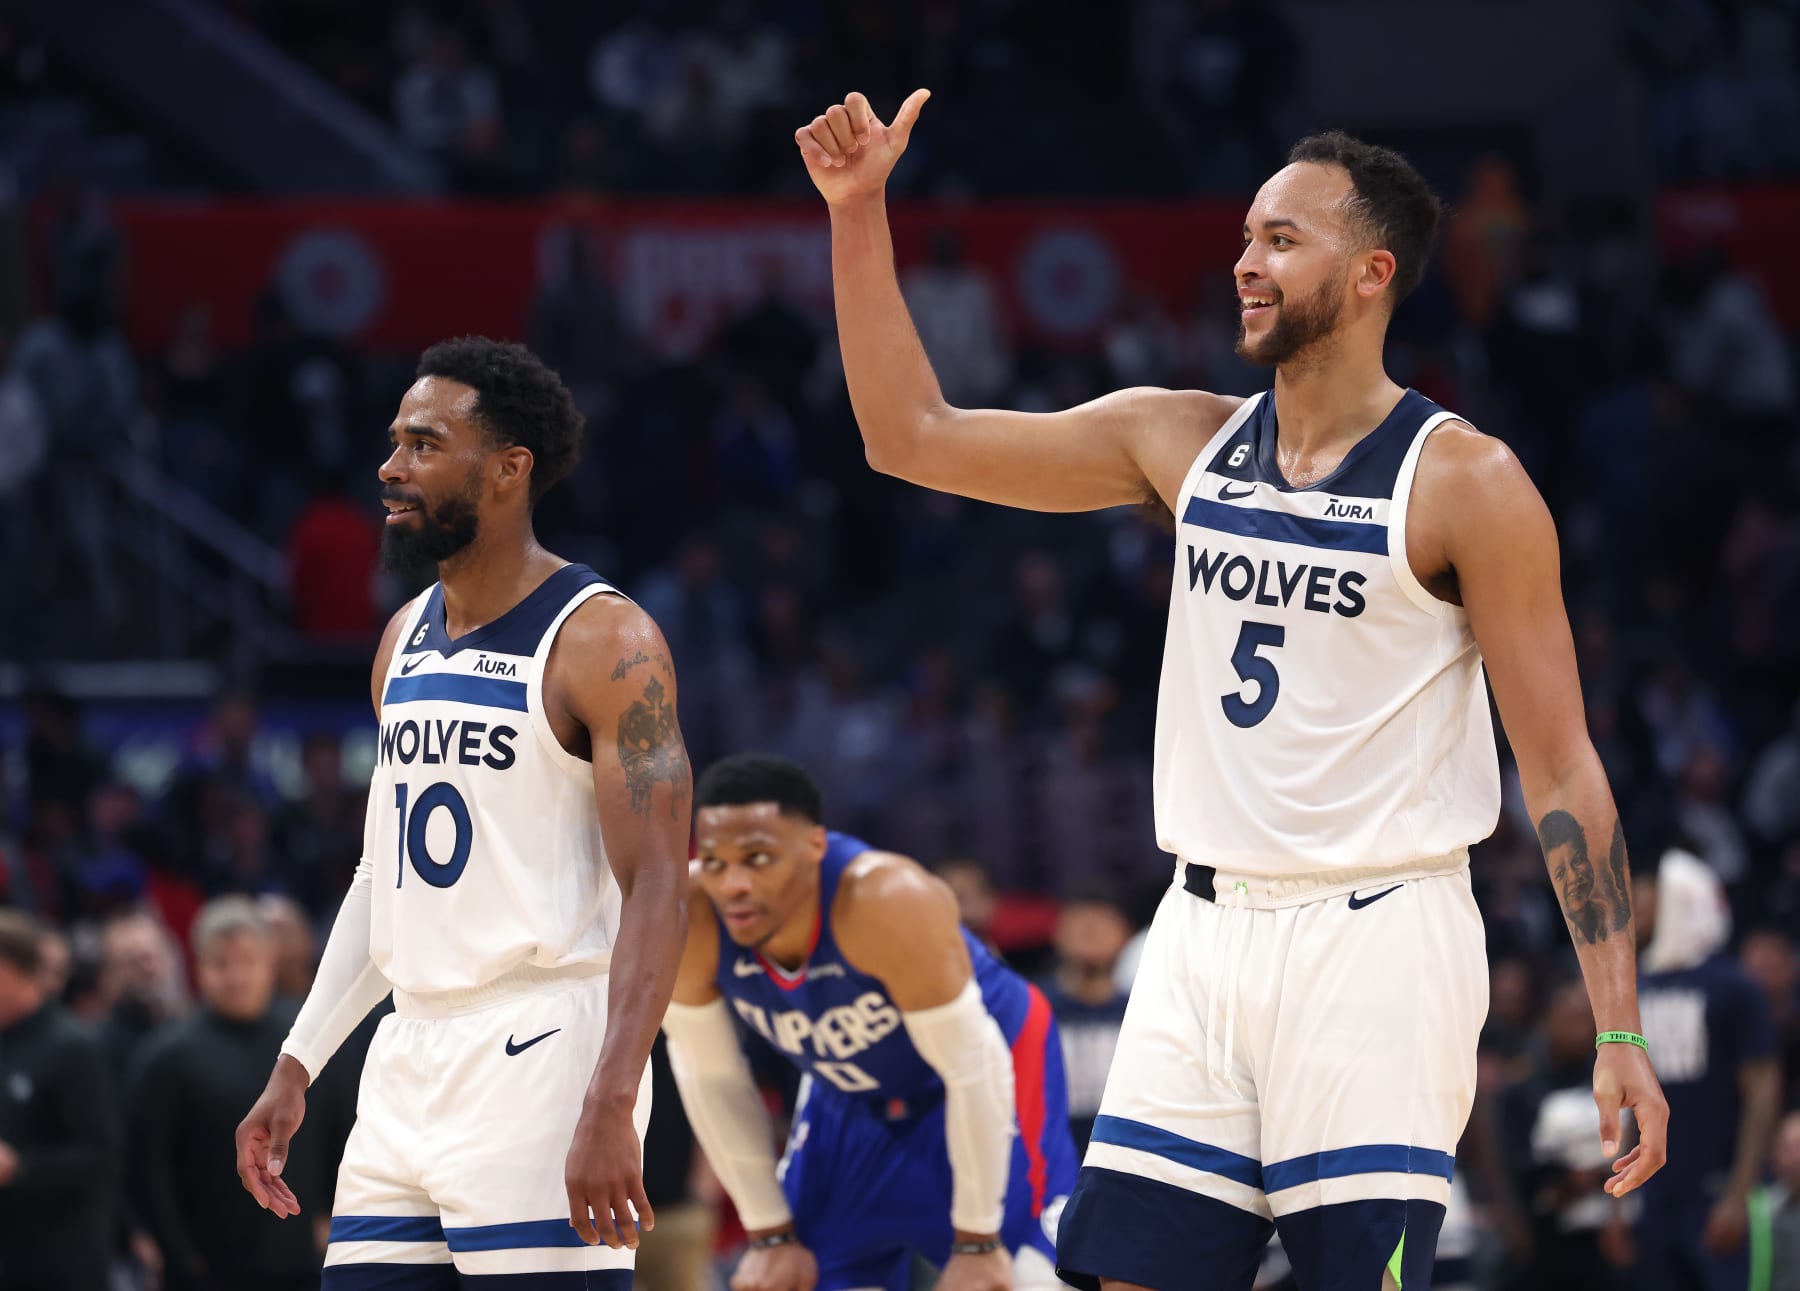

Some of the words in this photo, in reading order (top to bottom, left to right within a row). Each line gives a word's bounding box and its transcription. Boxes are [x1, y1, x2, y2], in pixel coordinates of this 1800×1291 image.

[1228, 445, 1249, 467] 6
[1187, 545, 1368, 618] WOLVES
[412, 623, 430, 646] 6
[1221, 620, 1285, 728] 5
[380, 719, 519, 770] WOLVES
[395, 781, 473, 888] 10
[813, 1061, 880, 1092] 0
